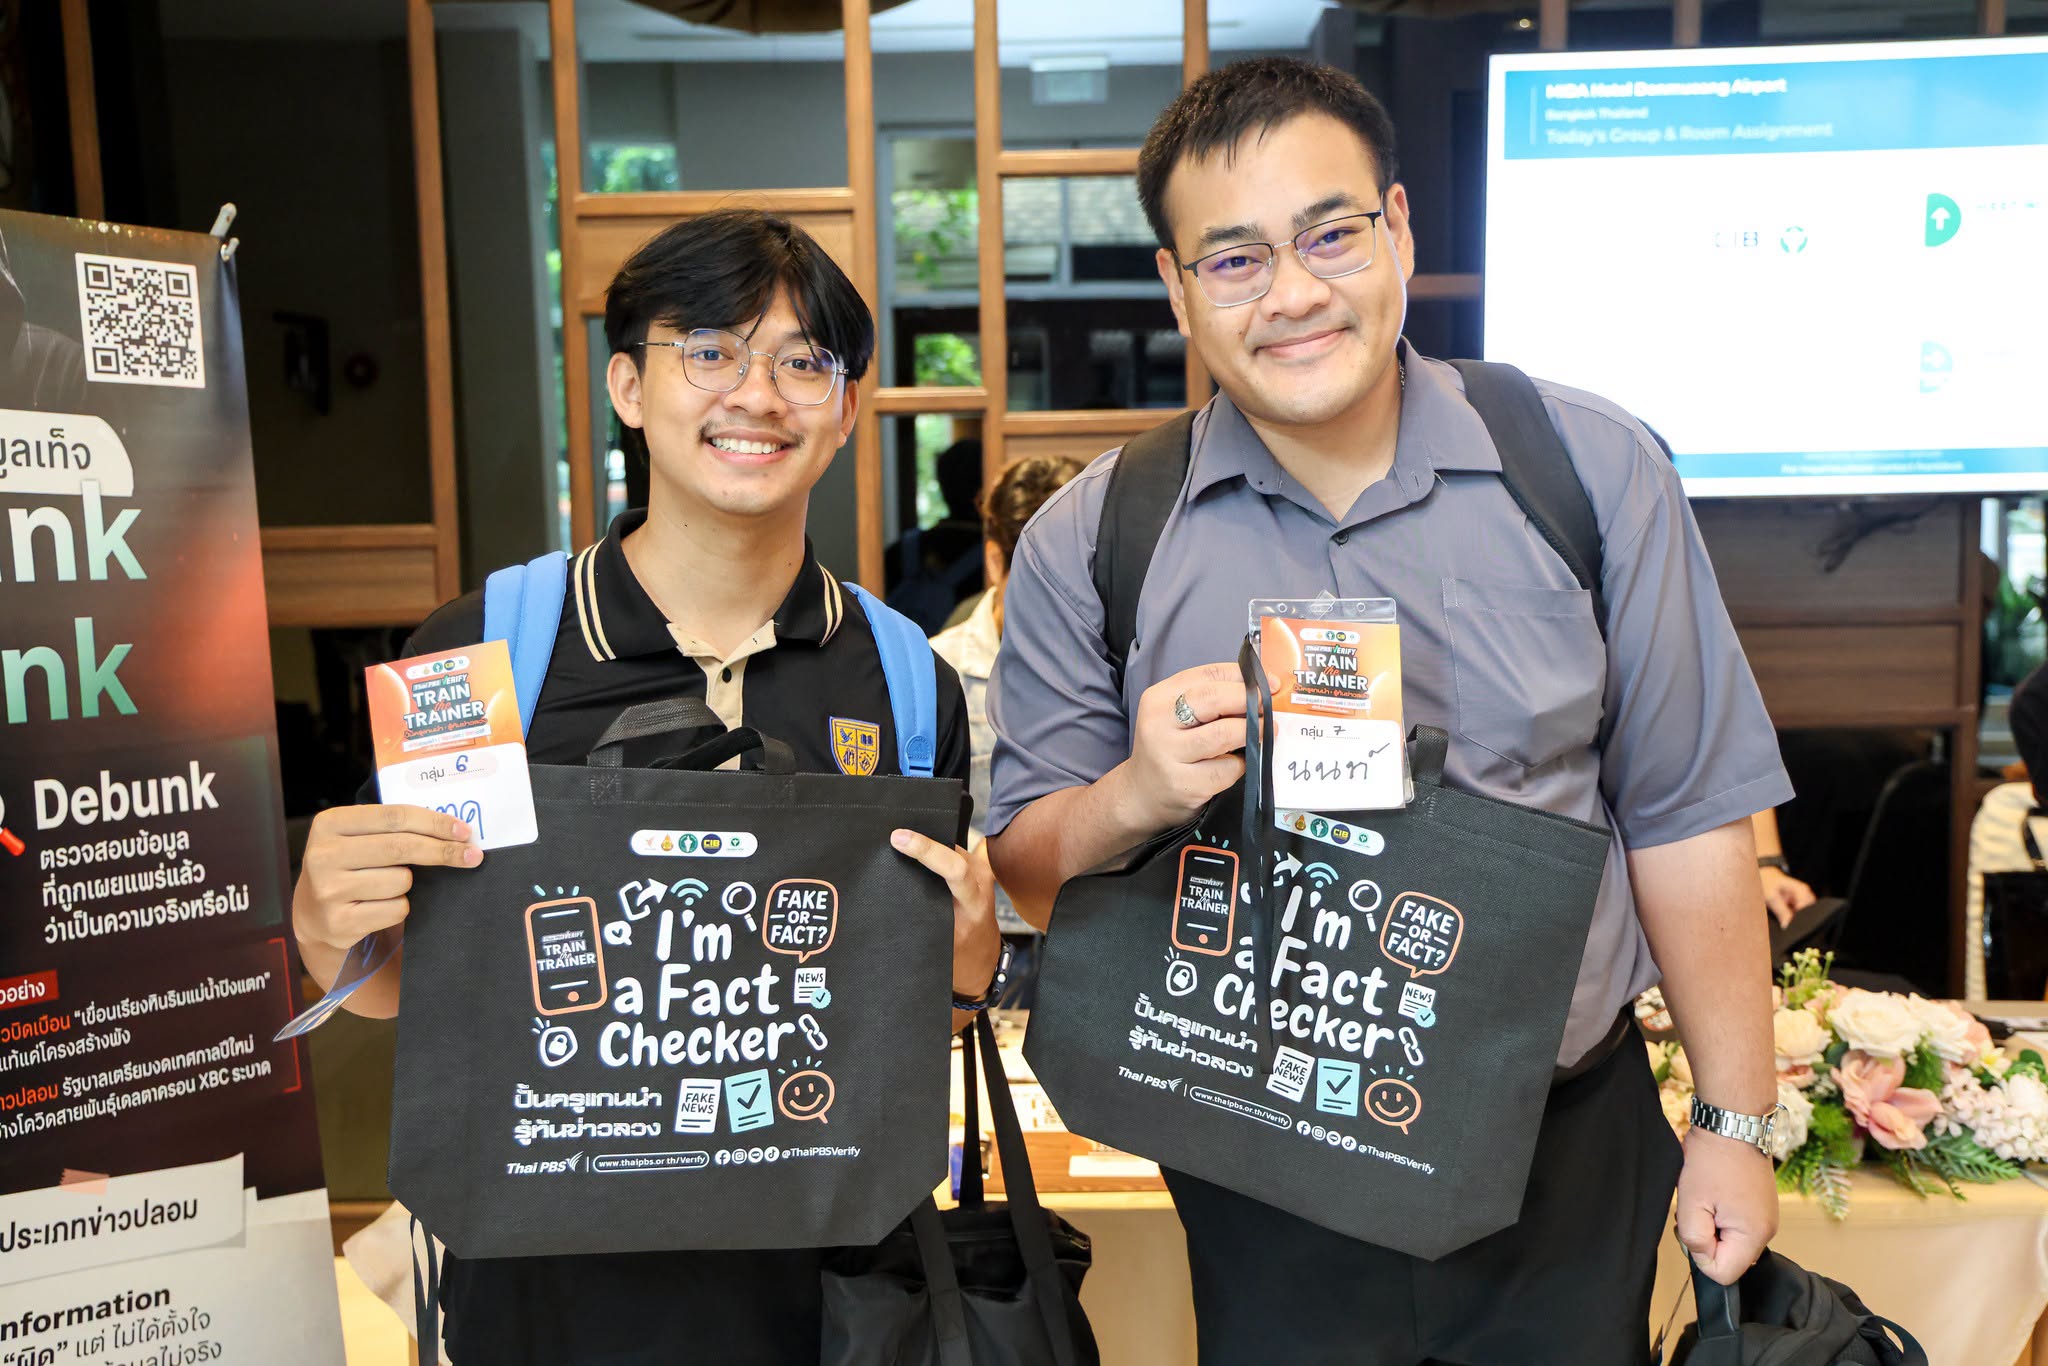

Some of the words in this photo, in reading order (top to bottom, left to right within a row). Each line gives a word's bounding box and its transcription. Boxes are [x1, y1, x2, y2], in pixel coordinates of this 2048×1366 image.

[1731, 79, 1788, 96] Airport
[1610, 126, 1662, 144] Group
[1680, 126, 1730, 141] Room
[1732, 122, 1834, 142] Assignment
[0, 478, 148, 583] nk
[1304, 653, 1358, 672] TRAIN
[1293, 670, 1369, 691] TRAINER
[412, 683, 471, 708] TRAIN
[403, 701, 485, 730] TRAINER
[1300, 726, 1324, 740] กลุ่ม
[1332, 725, 1346, 736] 7
[419, 766, 445, 783] กลุ่ม
[455, 754, 469, 772] 6
[34, 760, 220, 831] Debunk
[703, 838, 721, 848] CIB
[1333, 828, 1349, 838] CIB
[40, 829, 190, 870] ตรวจสอบข้อมูล
[42, 858, 206, 912] ที่ถูกเผยแพร่แล้ว
[1189, 885, 1224, 901] TRAIN
[777, 889, 829, 910] FAKE
[1181, 897, 1230, 915] TRAINER
[44, 884, 250, 944] ว่าเป็นความจริงหรือไม่
[787, 910, 810, 925] OR
[1281, 885, 1351, 950] I'm
[1400, 900, 1455, 935] FAKE
[655, 908, 733, 962] I'm
[769, 924, 829, 945] FACT?
[1408, 924, 1430, 943] OR
[543, 940, 587, 956] TRAIN
[1387, 933, 1447, 967] FACT?
[536, 952, 597, 971] TRAINER
[797, 973, 825, 984] NEWS
[1270, 935, 1389, 1017] Fact
[613, 976, 645, 1015] a
[656, 962, 781, 1022] Fact
[1404, 986, 1434, 1004] NEWS
[1134, 992, 1259, 1054] ปั้นครูแกนนำ
[599, 1020, 796, 1068] Checker
[1128, 1025, 1255, 1079] รู้ทันข่าวลวง
[199, 1068, 230, 1091] XBC
[232, 1059, 272, 1083] ระบาด
[1118, 1066, 1143, 1082] Thai
[1144, 1074, 1169, 1090] PBS
[1274, 1065, 1305, 1087] NEWS
[1278, 1058, 1308, 1078] FAKE
[514, 1082, 662, 1114] ปั้นครูแกนนำ
[680, 1102, 715, 1115] NEWS
[684, 1091, 716, 1104] FAKE
[1194, 1090, 1289, 1126] www.thaipbs.or.th/Verify
[513, 1117, 662, 1147] รู้ทันข่าวลวง
[598, 1154, 706, 1169] www.thaipbs.orth/Verify
[781, 1145, 861, 1160] @ThaiPBSVerify
[1358, 1143, 1435, 1175] @ThaiPBSVerify
[506, 1162, 538, 1175] Thai
[540, 1161, 568, 1174] PBS
[0, 1199, 198, 1253] ประเภทข่าวปลอม
[0, 1288, 171, 1342] nformation
[76, 1330, 105, 1359] แต่
[113, 1306, 211, 1350] ไม่ได้ตั้งใจ
